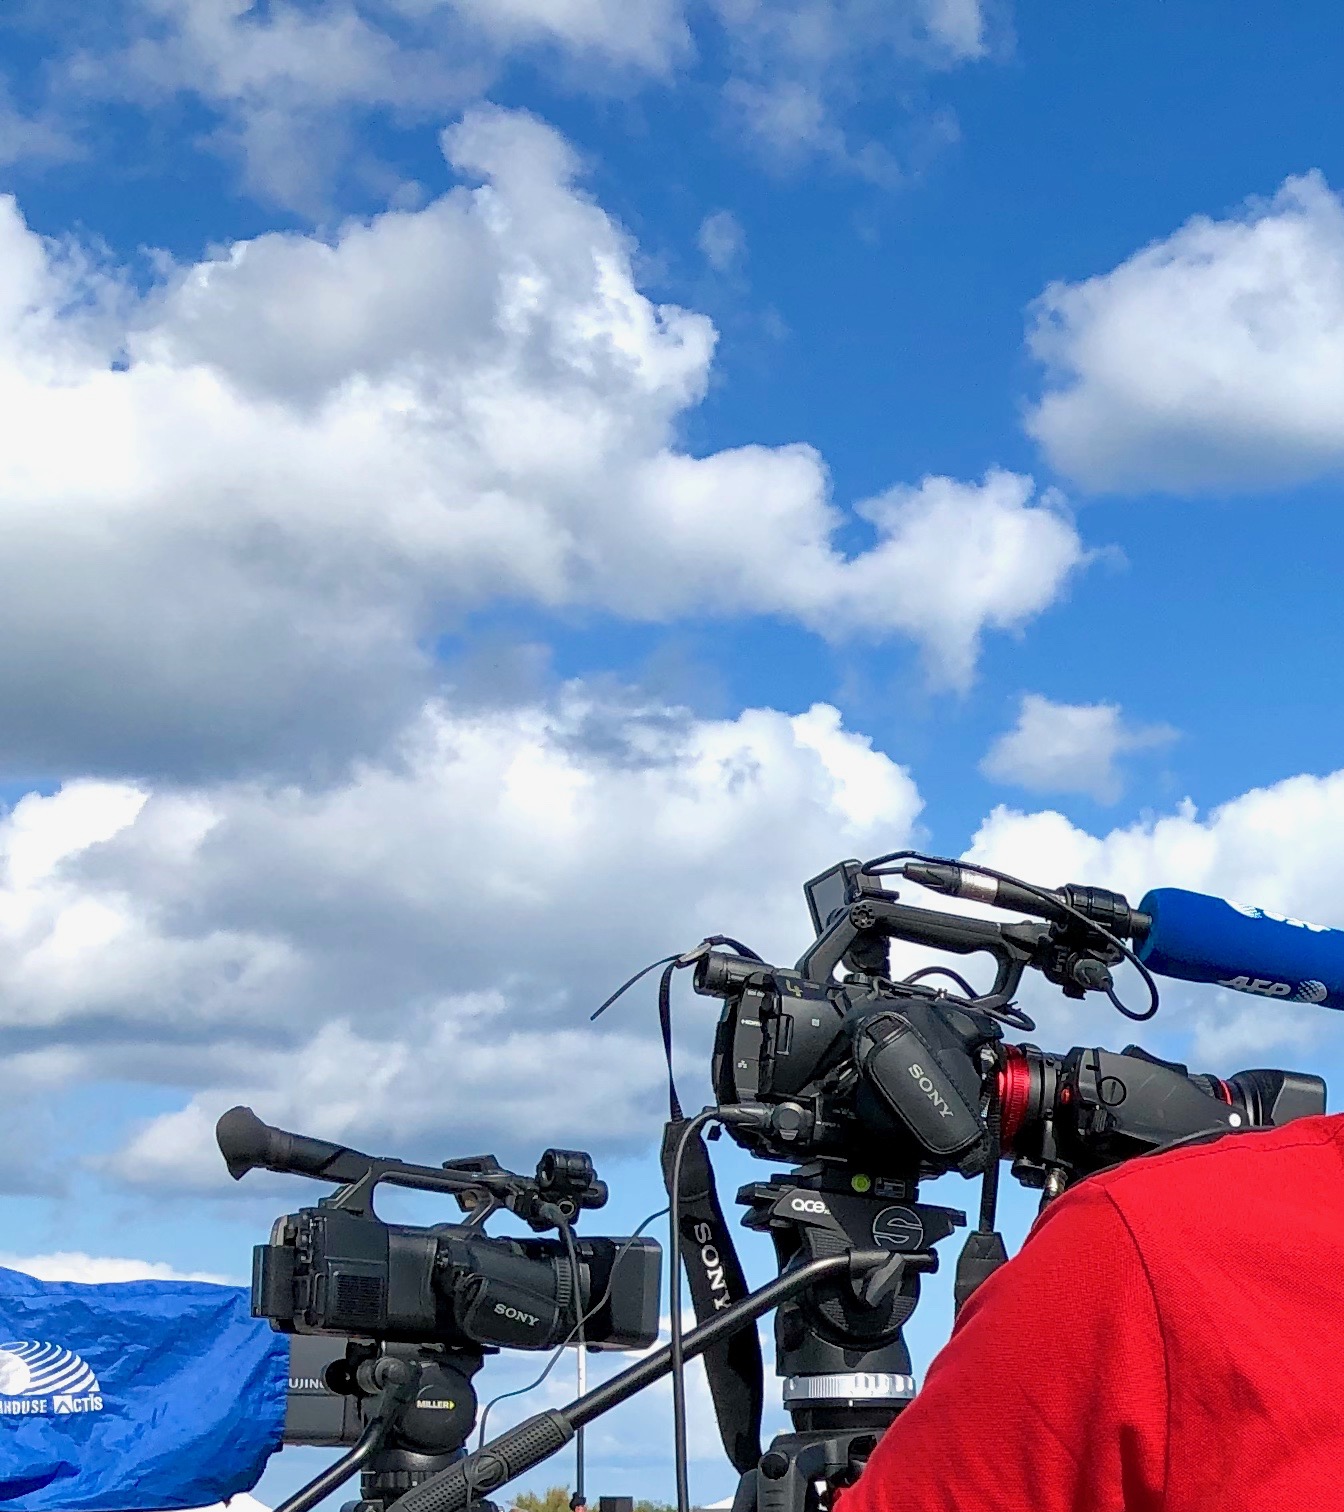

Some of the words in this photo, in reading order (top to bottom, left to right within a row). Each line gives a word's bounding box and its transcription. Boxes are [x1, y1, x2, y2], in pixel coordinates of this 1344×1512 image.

[908, 1063, 954, 1118] SONY
[791, 1198, 826, 1214] ace
[694, 1222, 732, 1311] SONY
[494, 1303, 540, 1326] SONY
[288, 1377, 325, 1389] UJIN
